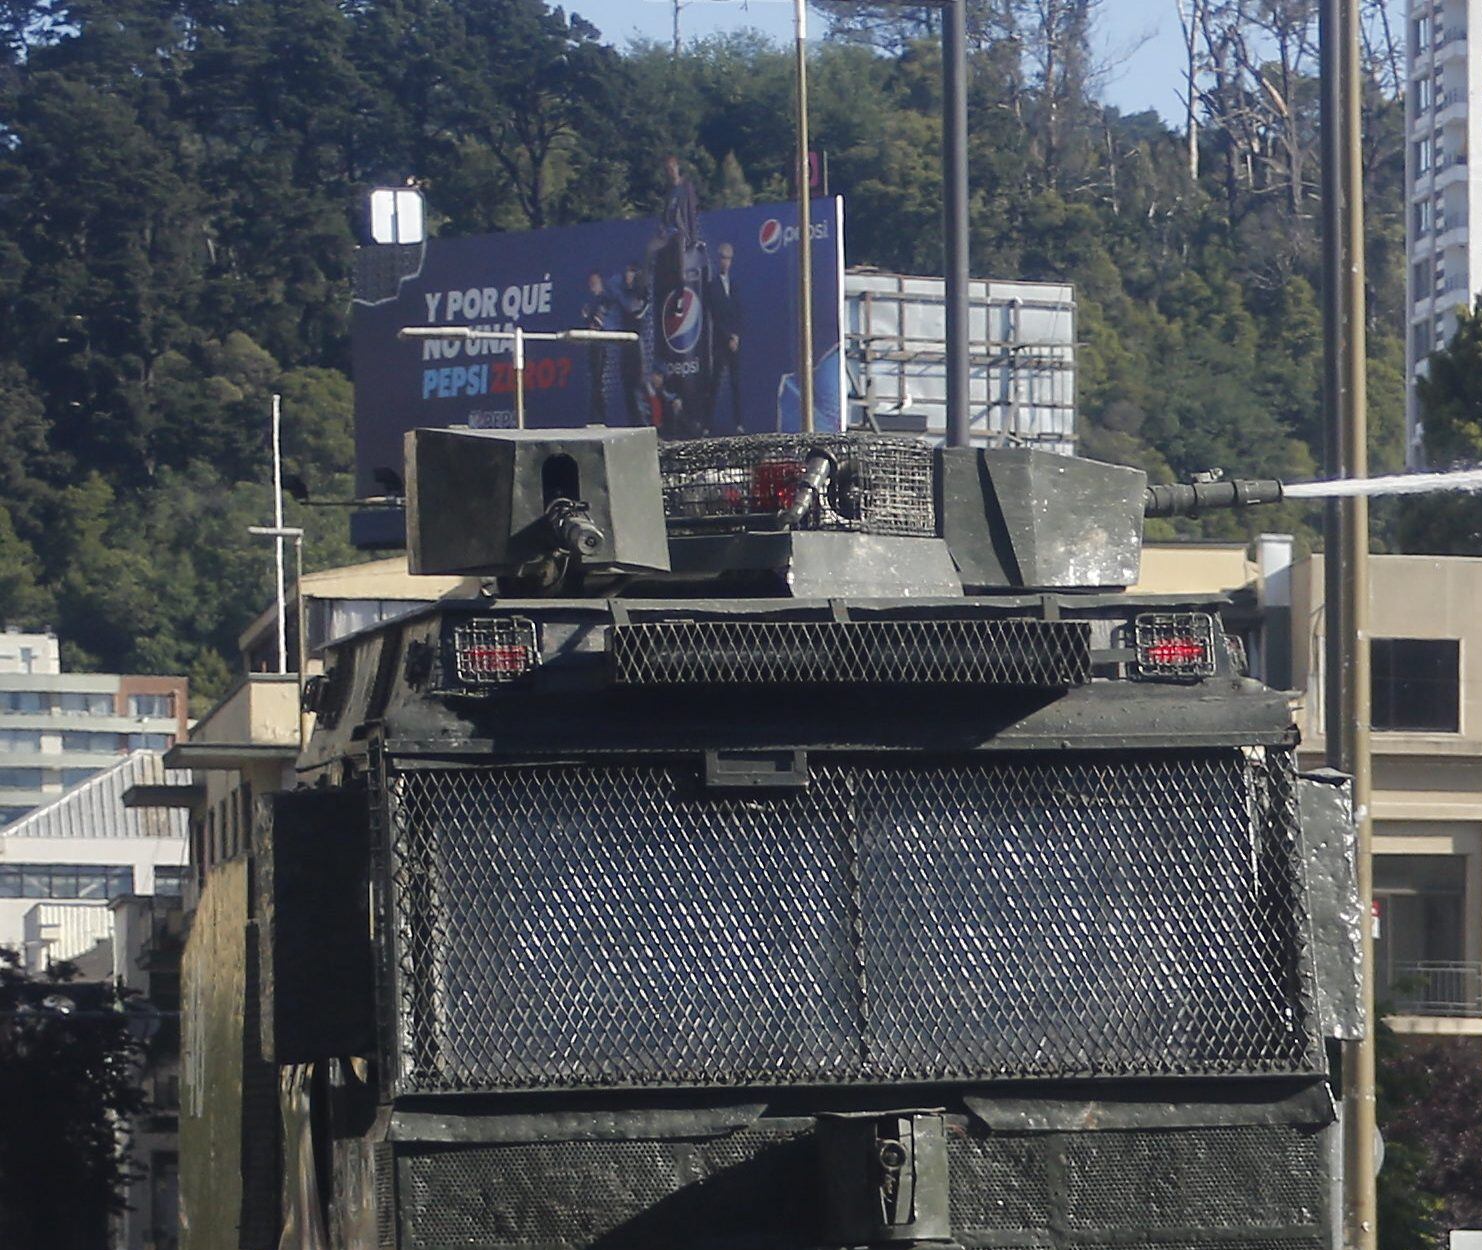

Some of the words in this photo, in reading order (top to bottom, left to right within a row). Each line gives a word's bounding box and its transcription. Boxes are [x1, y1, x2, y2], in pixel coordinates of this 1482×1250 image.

[425, 293, 441, 322] Y
[446, 287, 498, 321] POR
[502, 273, 553, 321] QUÉ
[422, 334, 461, 361] NO
[464, 323, 516, 356] UNA
[423, 364, 488, 399] PEPSI
